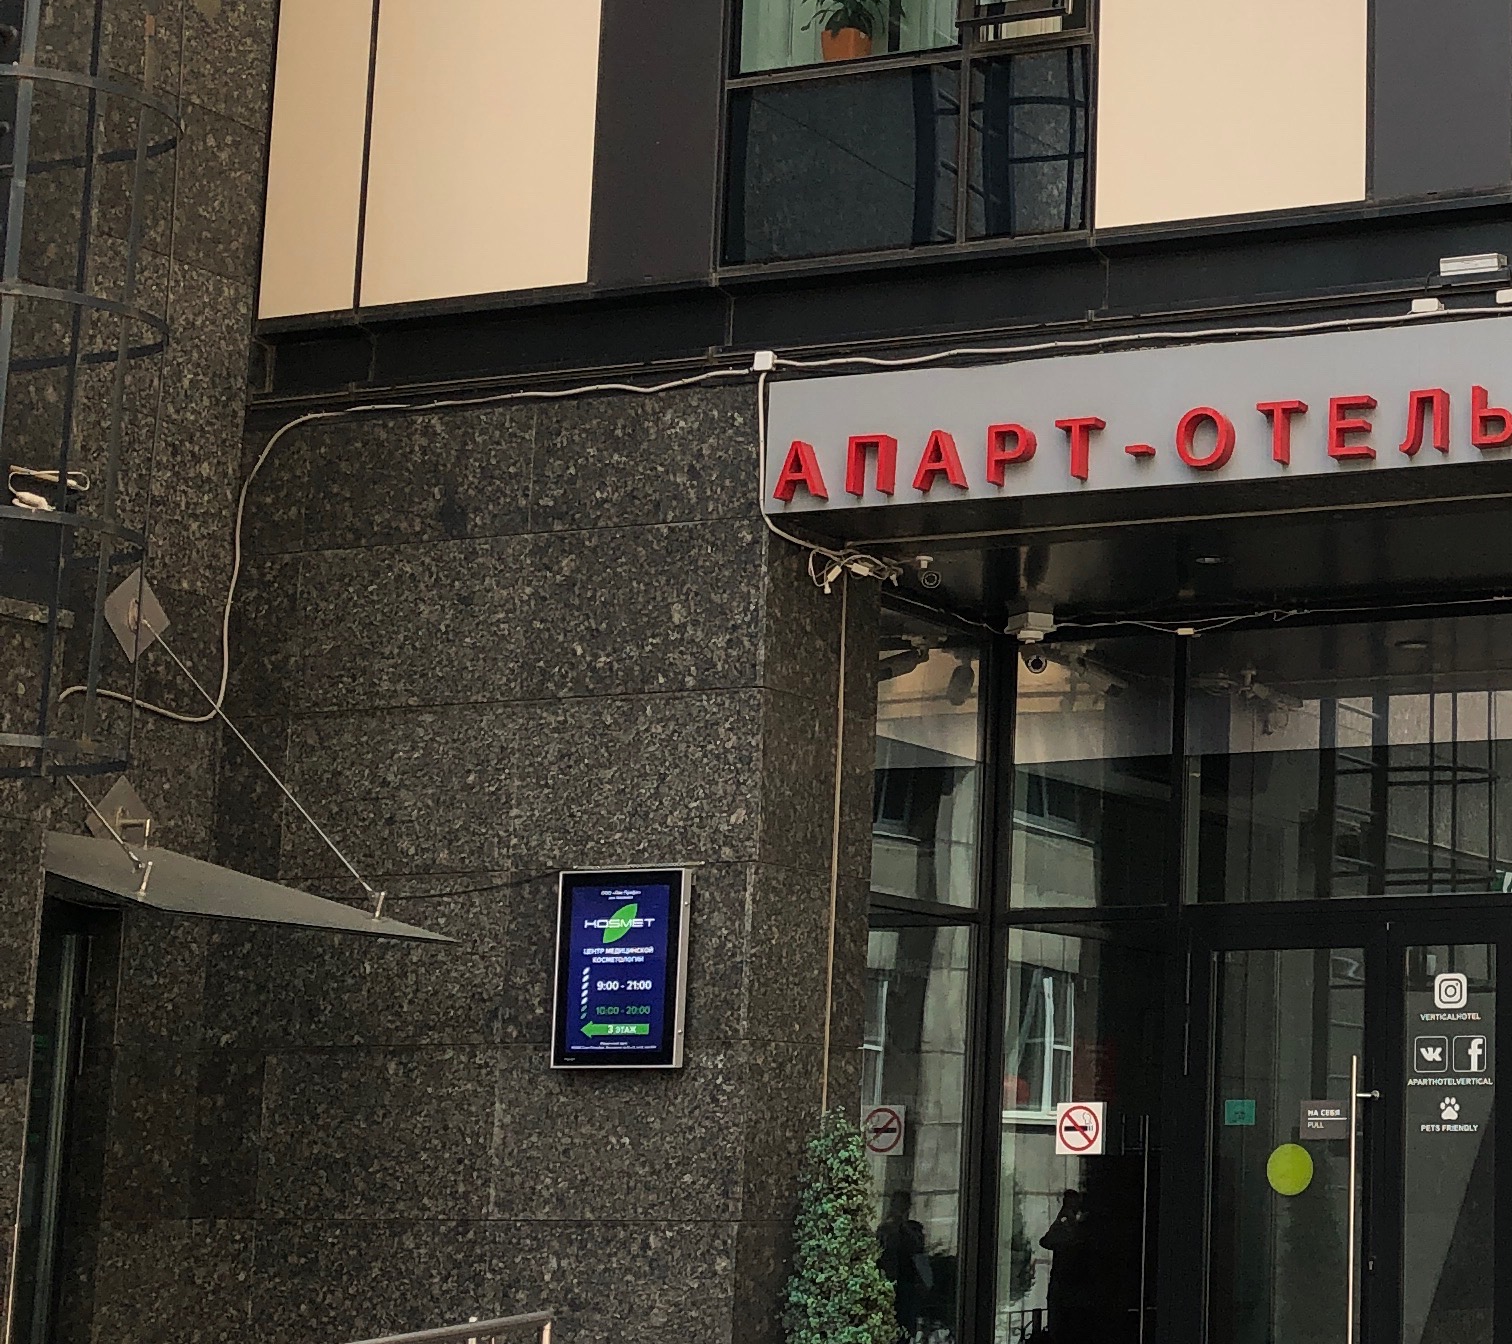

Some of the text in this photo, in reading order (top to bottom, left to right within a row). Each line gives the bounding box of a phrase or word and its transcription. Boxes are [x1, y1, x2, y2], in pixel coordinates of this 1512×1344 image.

[597, 981, 618, 991] 9:00
[626, 980, 652, 990] 21:00
[626, 1005, 651, 1014] 20:00
[607, 1024, 637, 1034] 3 ЭТАЖ
[1420, 1124, 1441, 1132] PETS
